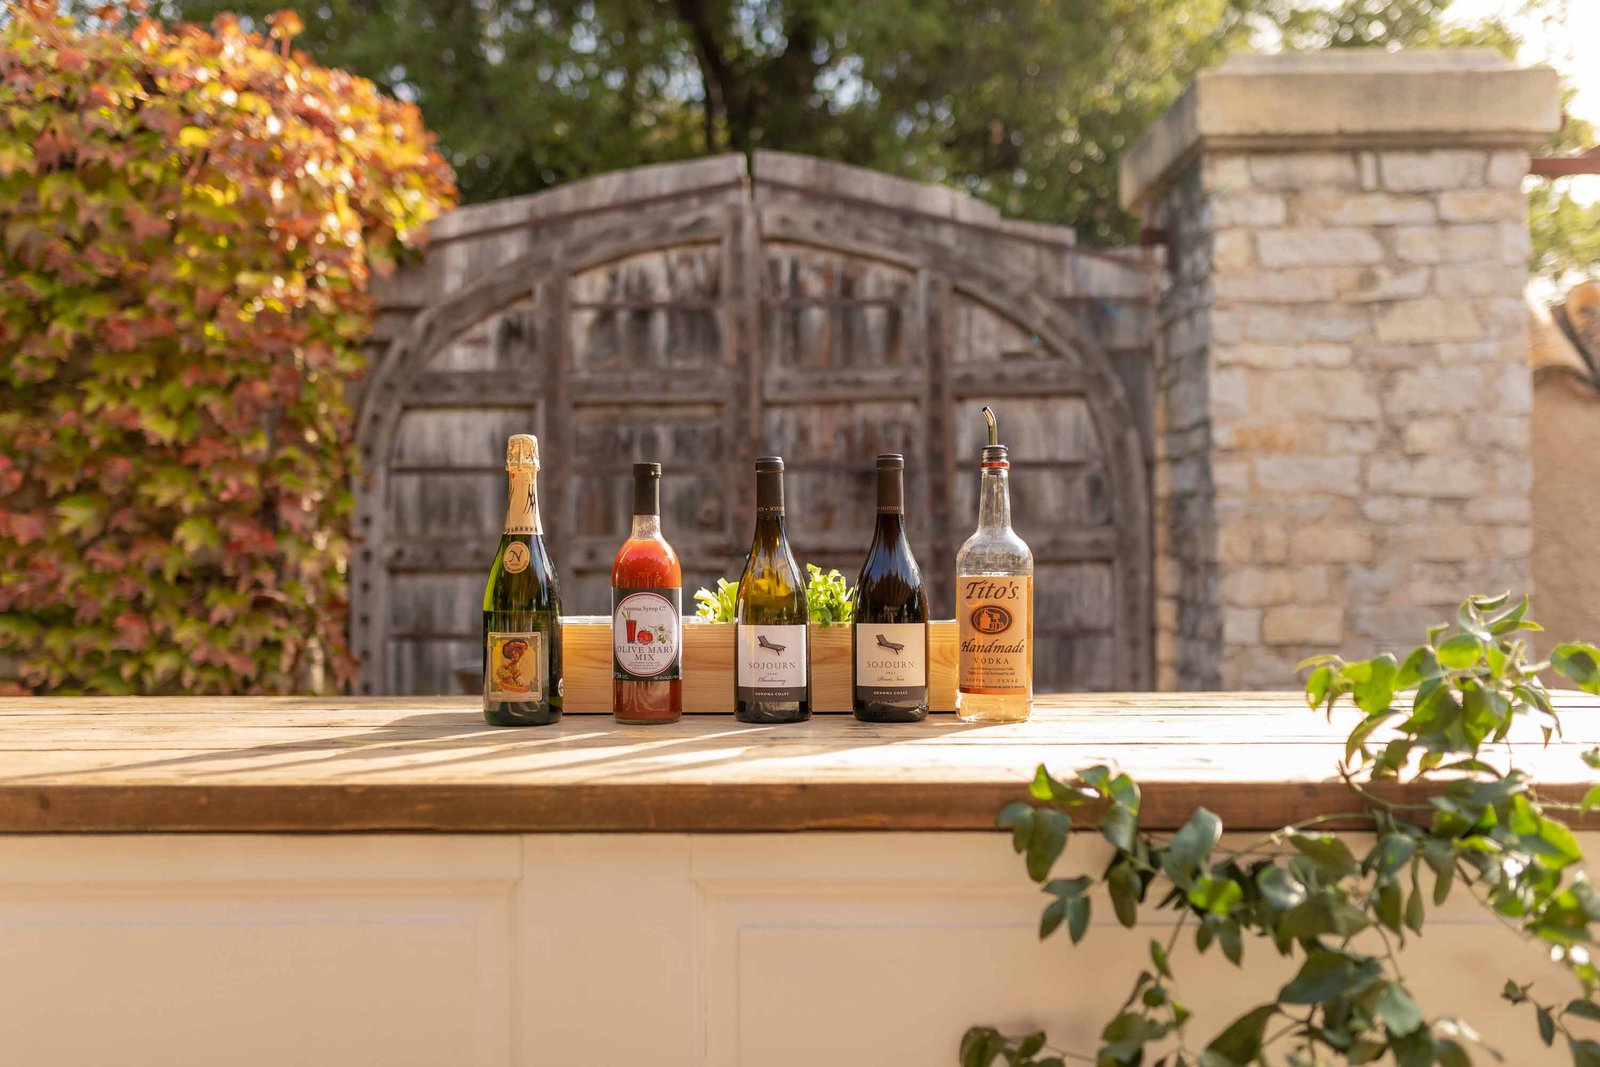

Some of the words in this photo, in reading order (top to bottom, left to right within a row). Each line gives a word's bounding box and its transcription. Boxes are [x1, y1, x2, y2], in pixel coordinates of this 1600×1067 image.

[965, 580, 1019, 599] Tito's
[617, 646, 644, 654] OLIVE
[648, 646, 674, 654] MARY
[961, 638, 1025, 653] Handmade
[748, 661, 796, 670] SOJOURN
[866, 660, 914, 669] SOJOURN
[973, 657, 1009, 665] VODKA
